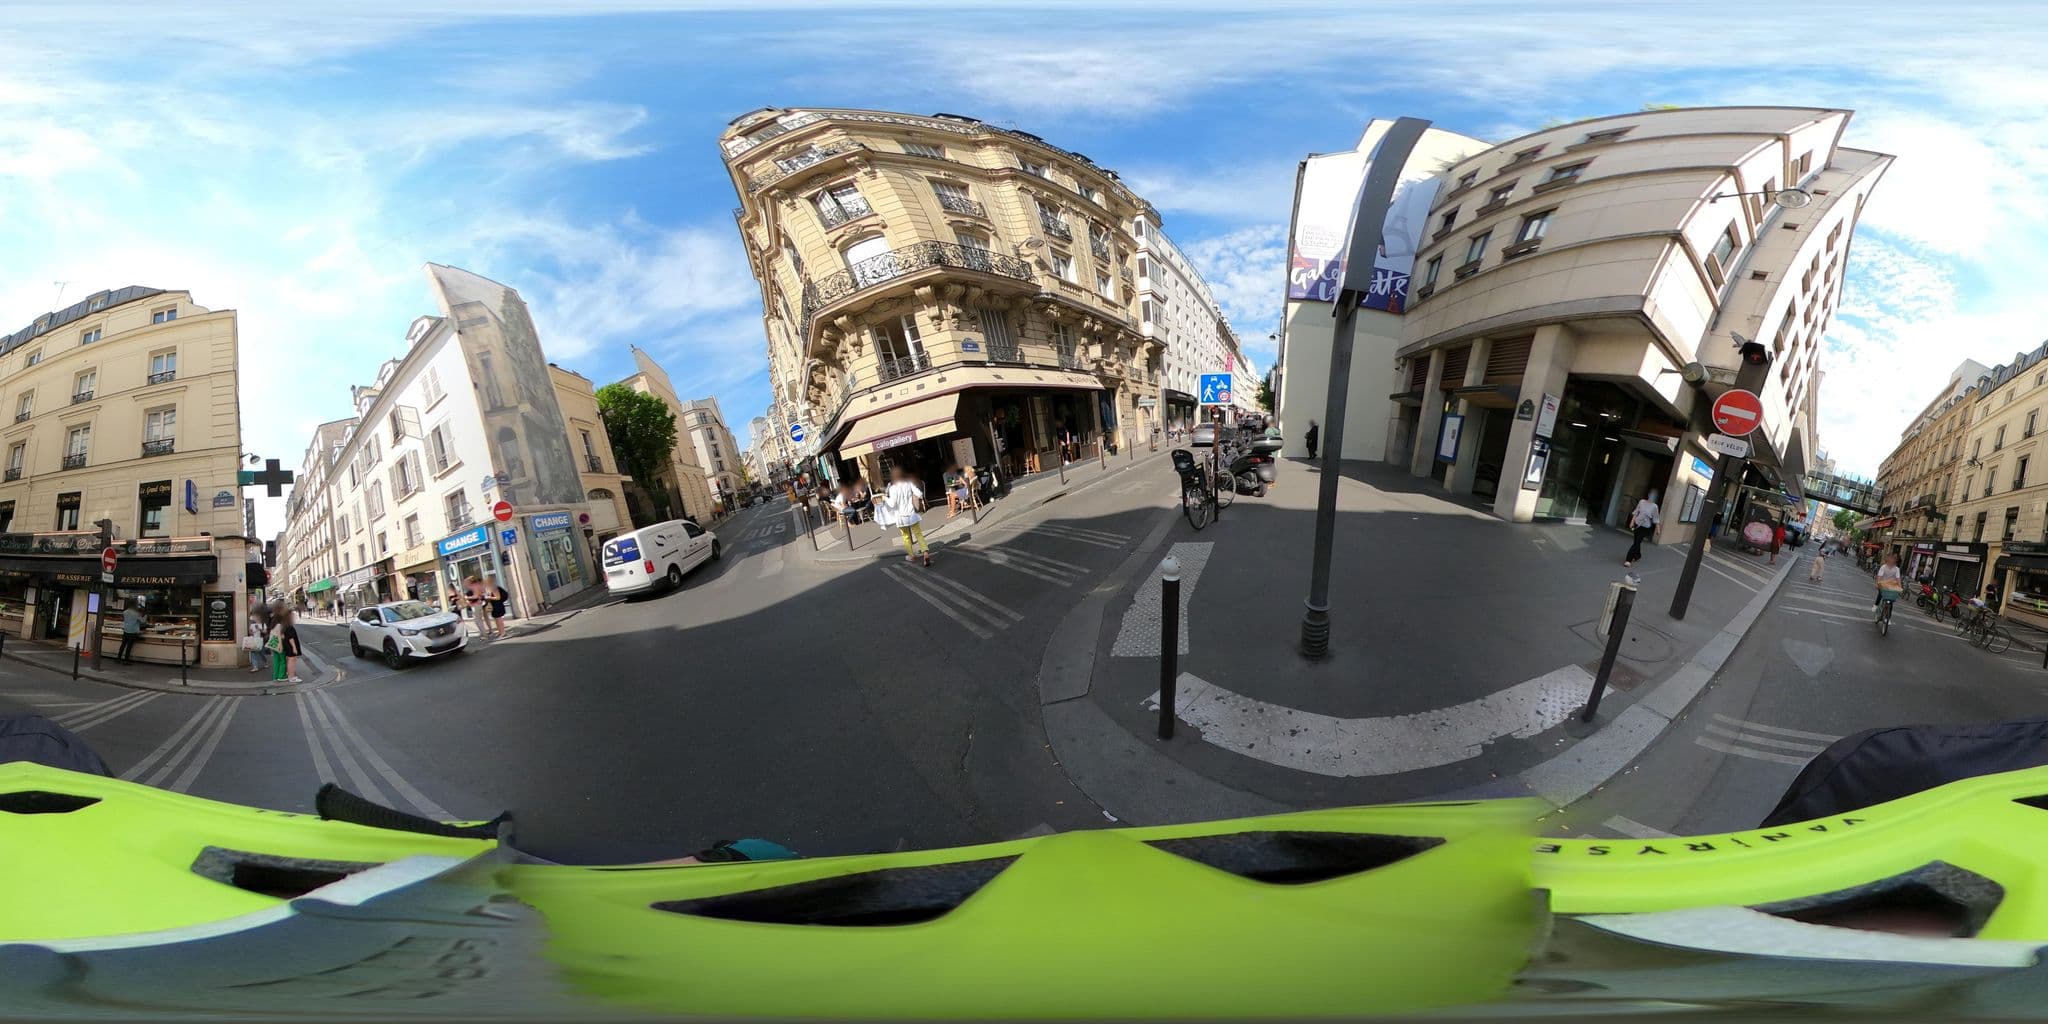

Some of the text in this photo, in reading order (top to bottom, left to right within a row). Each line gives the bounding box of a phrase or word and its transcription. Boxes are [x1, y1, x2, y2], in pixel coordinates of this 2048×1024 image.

[534, 515, 569, 528] CHANGE
[445, 531, 480, 551] CHANGE
[57, 572, 92, 582] BRASSERIE
[121, 576, 176, 584] RESTAURANT
